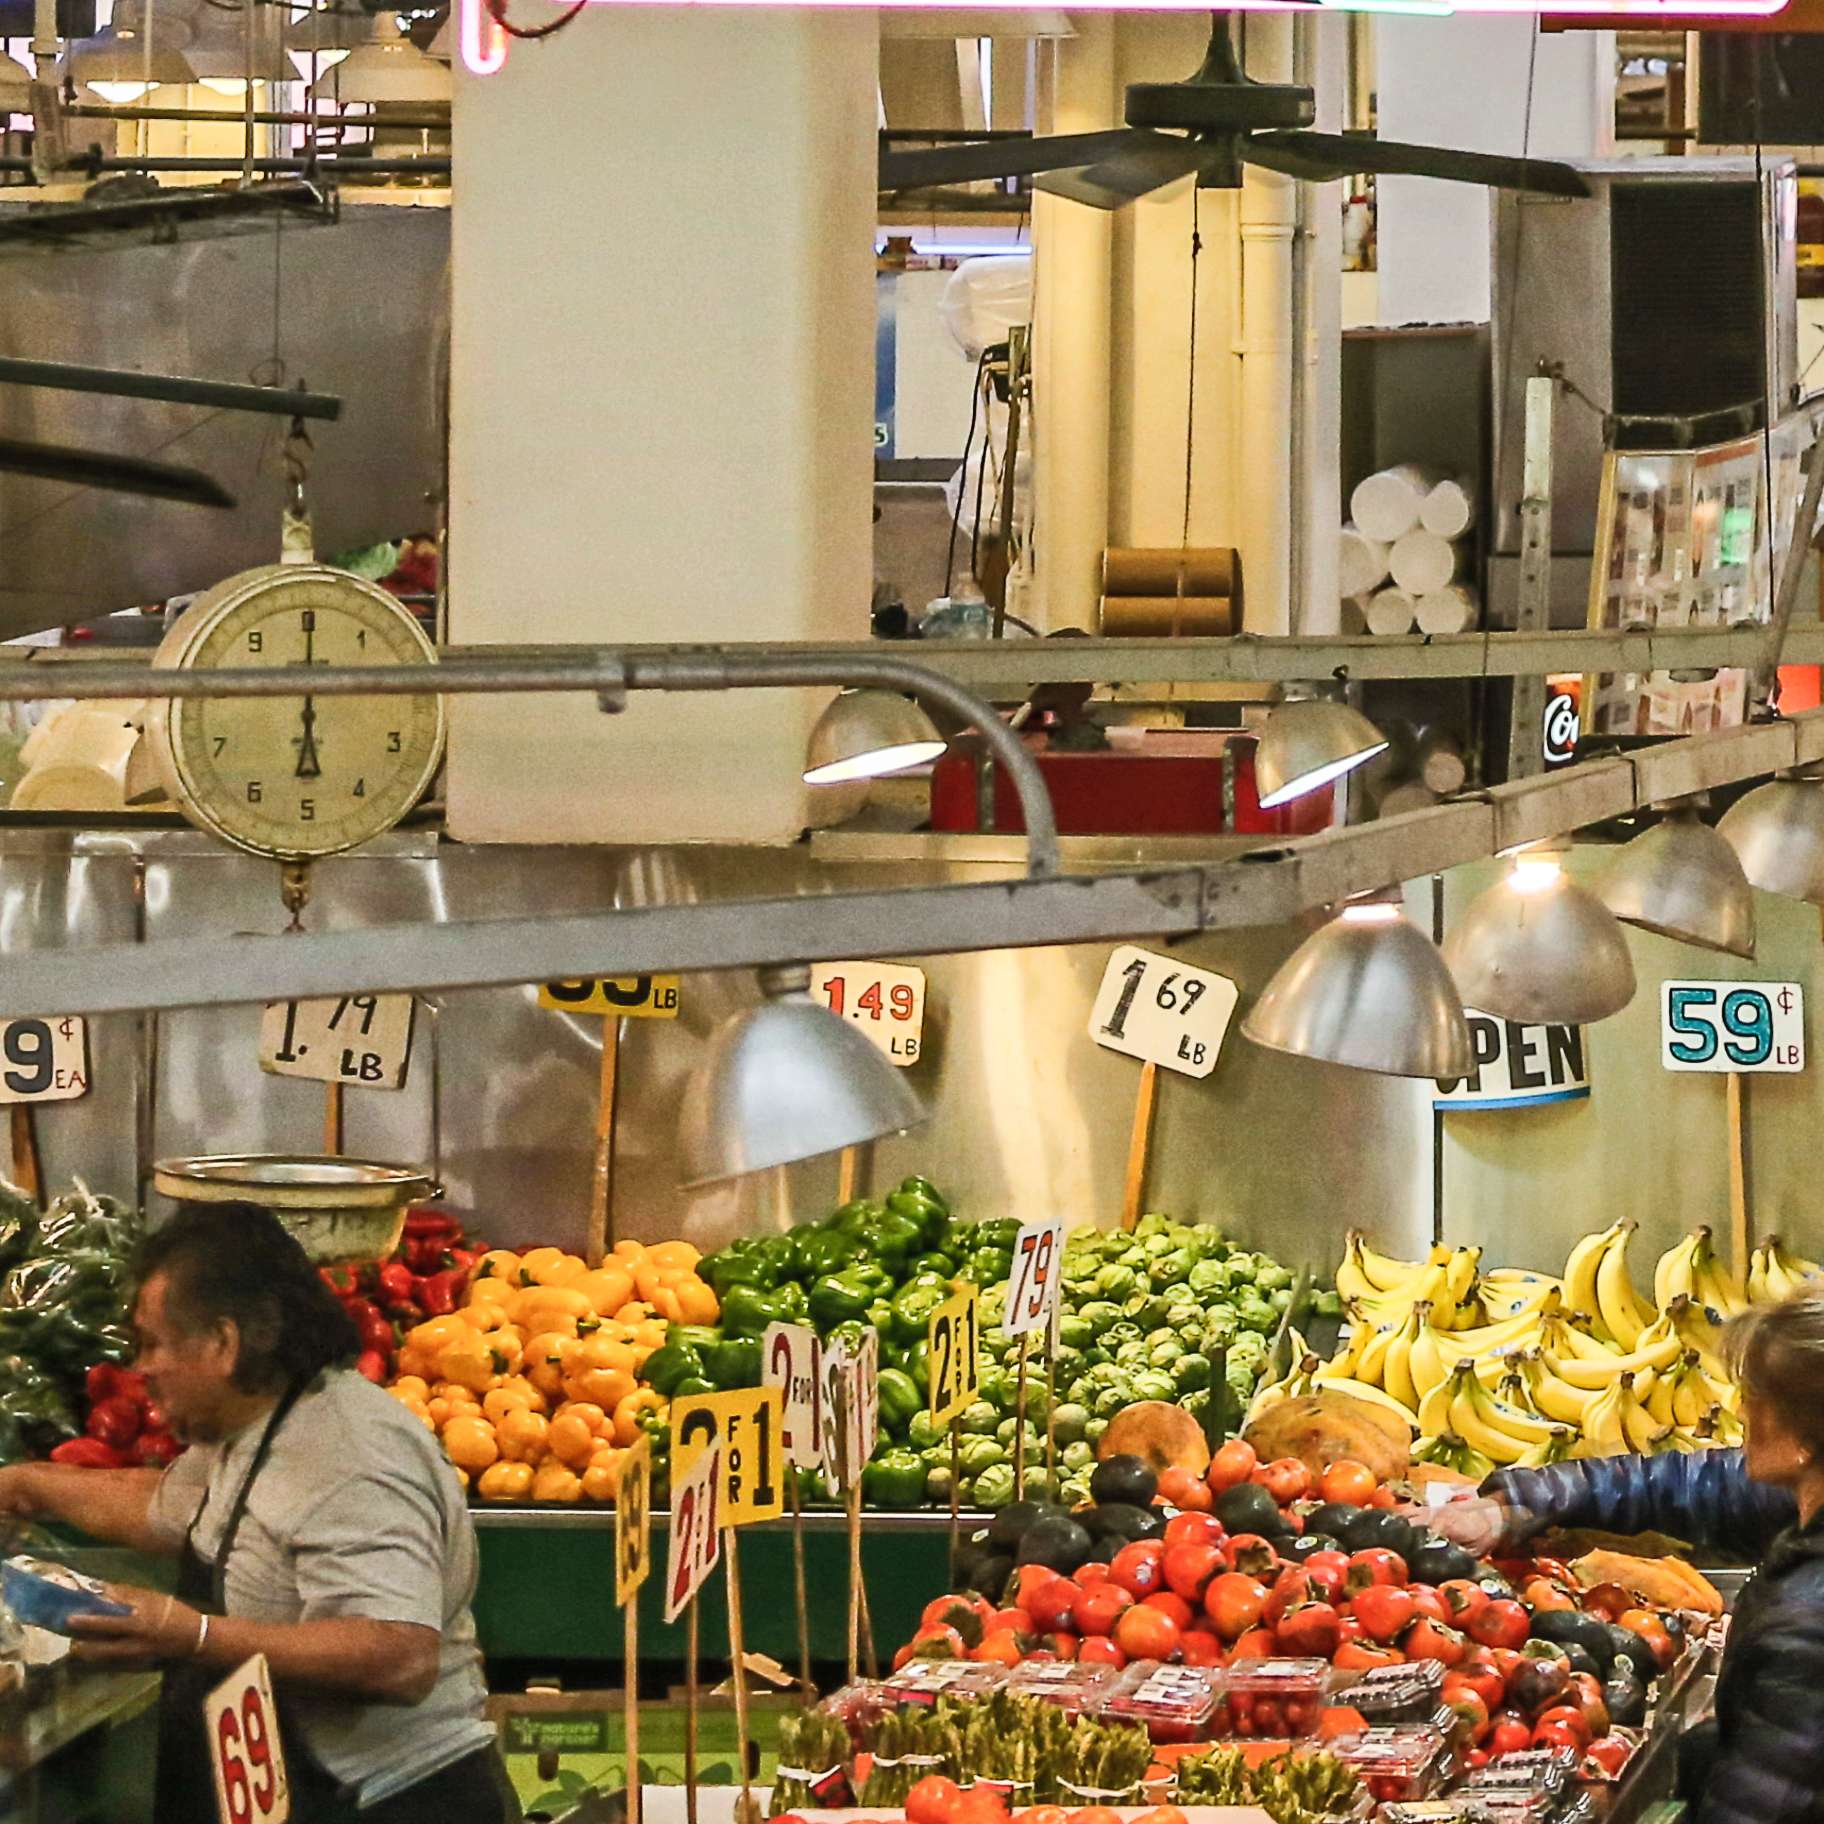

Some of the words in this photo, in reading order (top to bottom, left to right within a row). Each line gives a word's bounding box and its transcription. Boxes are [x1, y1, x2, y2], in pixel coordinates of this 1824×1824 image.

[248, 631, 263, 653] 9
[356, 629, 367, 649] 1
[213, 736, 228, 759] 7
[386, 731, 401, 753] 3
[246, 780, 262, 804] 6
[352, 777, 366, 798] 4
[300, 798, 315, 821] 5
[653, 988, 678, 1009] LB
[823, 976, 914, 1021] 1.49
[890, 1036, 919, 1056] LB
[1177, 1034, 1207, 1065] LB
[1434, 1017, 1586, 1095] PEN
[1776, 1045, 1800, 1066] LB
[54, 1069, 87, 1090] EA
[339, 1048, 384, 1081] LB
[1011, 1229, 1054, 1326] 79
[934, 1315, 951, 1414] 2
[966, 1297, 978, 1393] 1
[728, 1415, 742, 1505] FOR
[751, 1400, 775, 1507] 1
[672, 1485, 694, 1610] 2
[218, 1685, 276, 1824] 69
